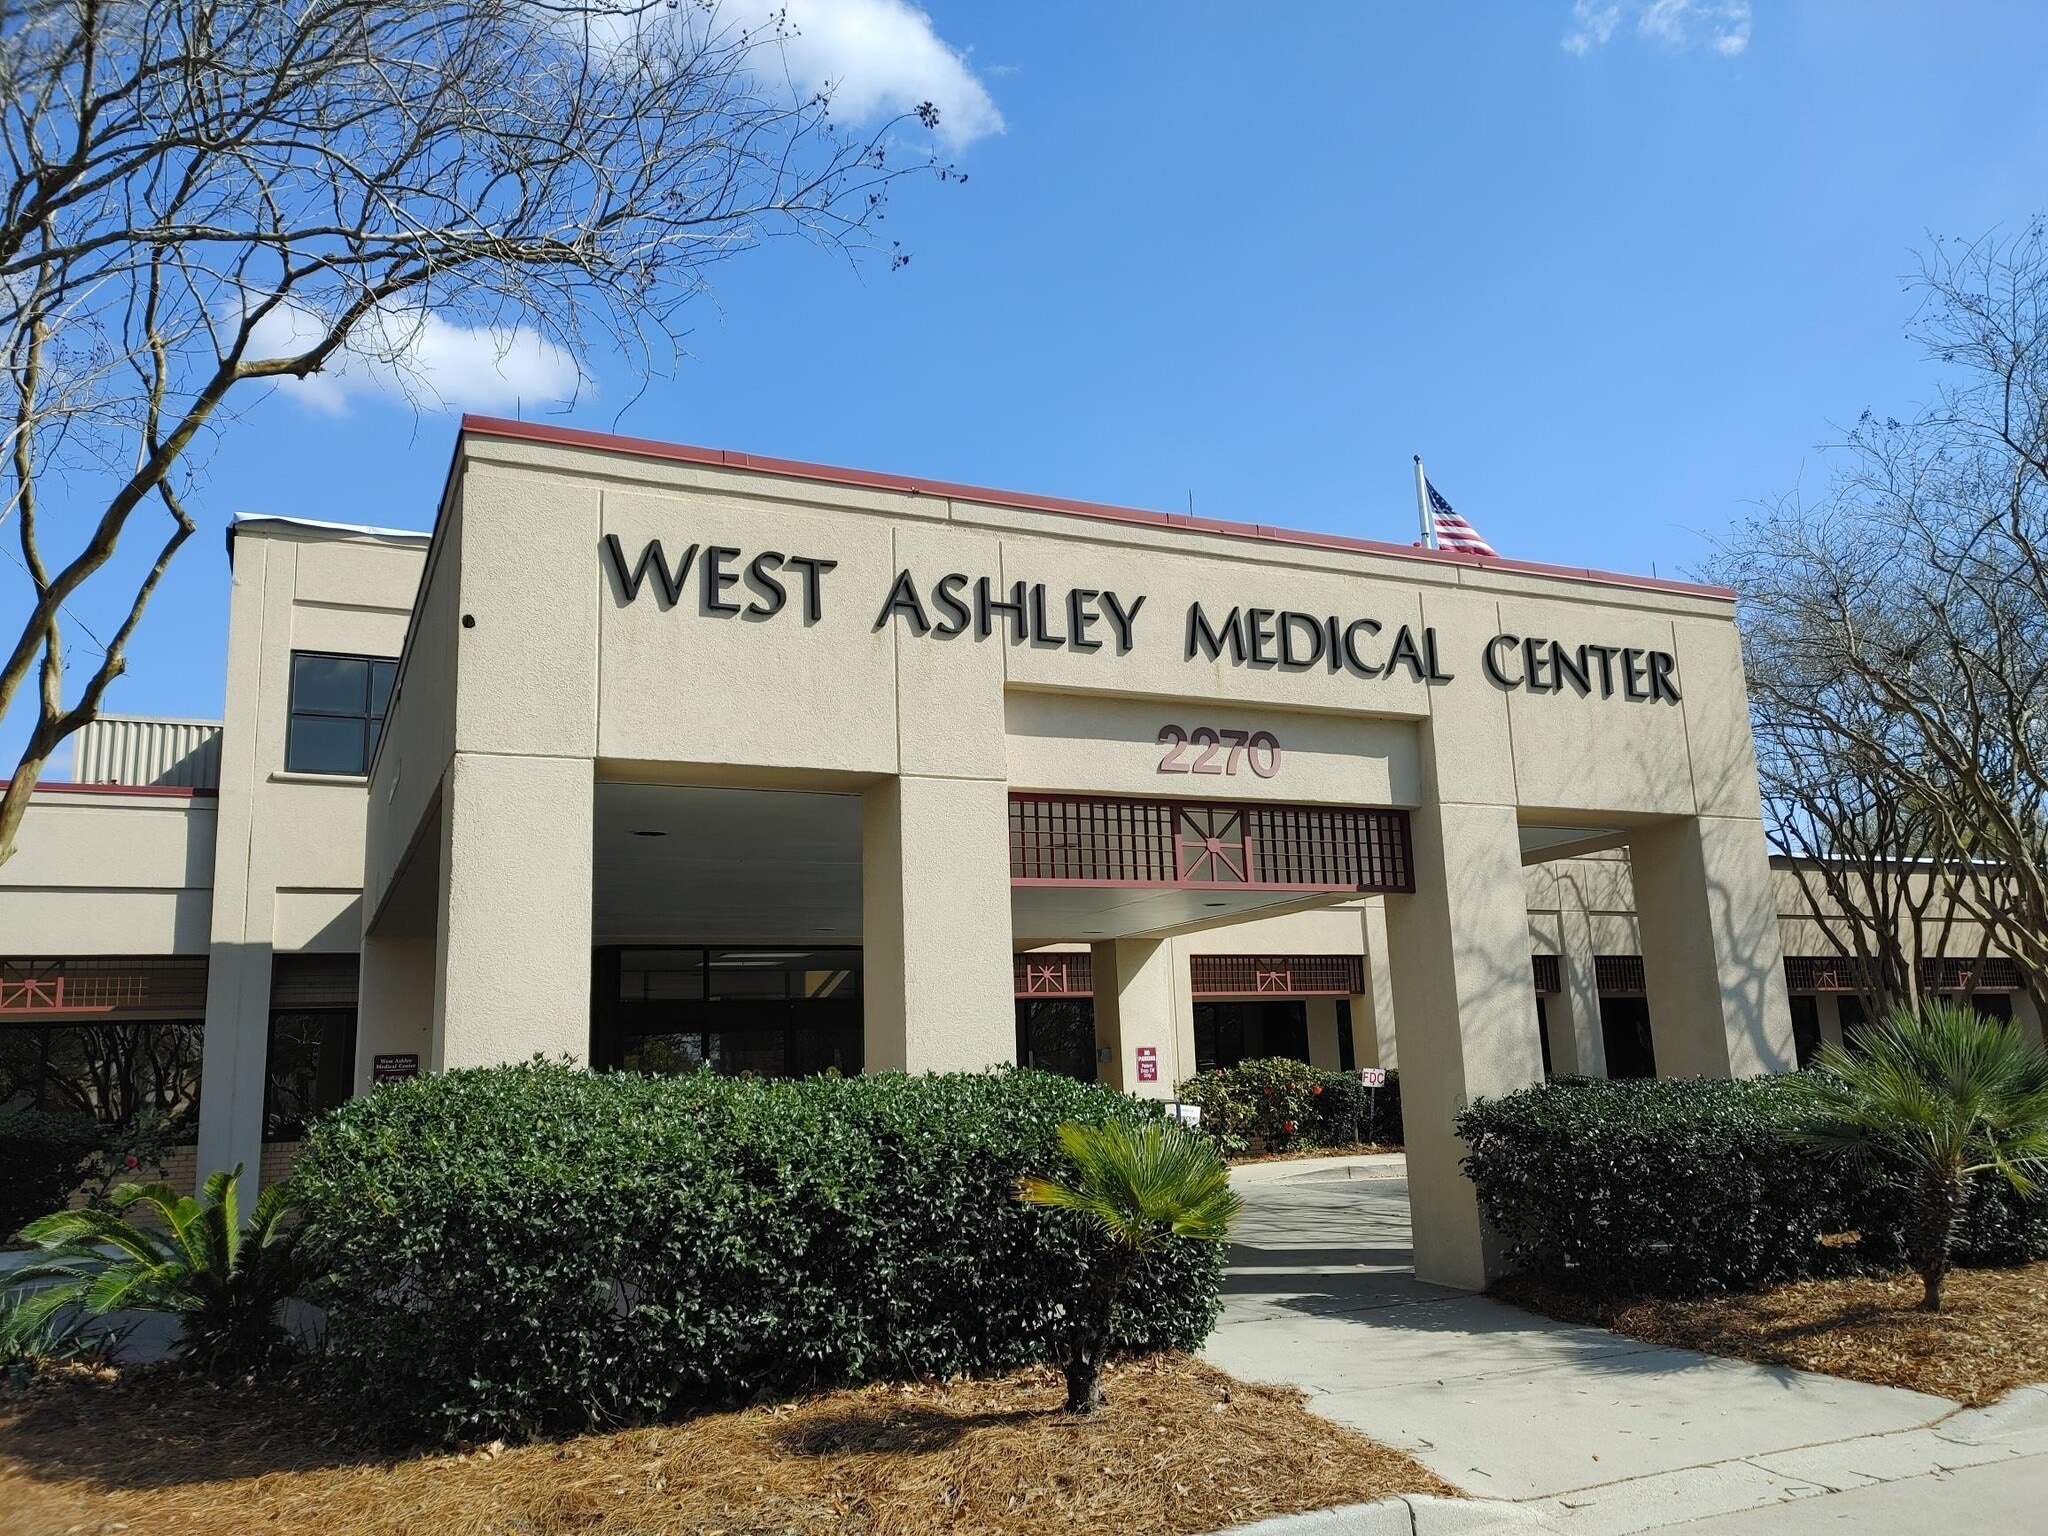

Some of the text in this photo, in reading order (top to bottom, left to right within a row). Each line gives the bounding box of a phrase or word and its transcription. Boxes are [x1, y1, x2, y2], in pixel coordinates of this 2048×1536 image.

[604, 533, 1682, 703] WEST ASHLEY MEDICAL CENTER
[1157, 724, 1282, 779] 2270
[1363, 1072, 1384, 1084] FDC
